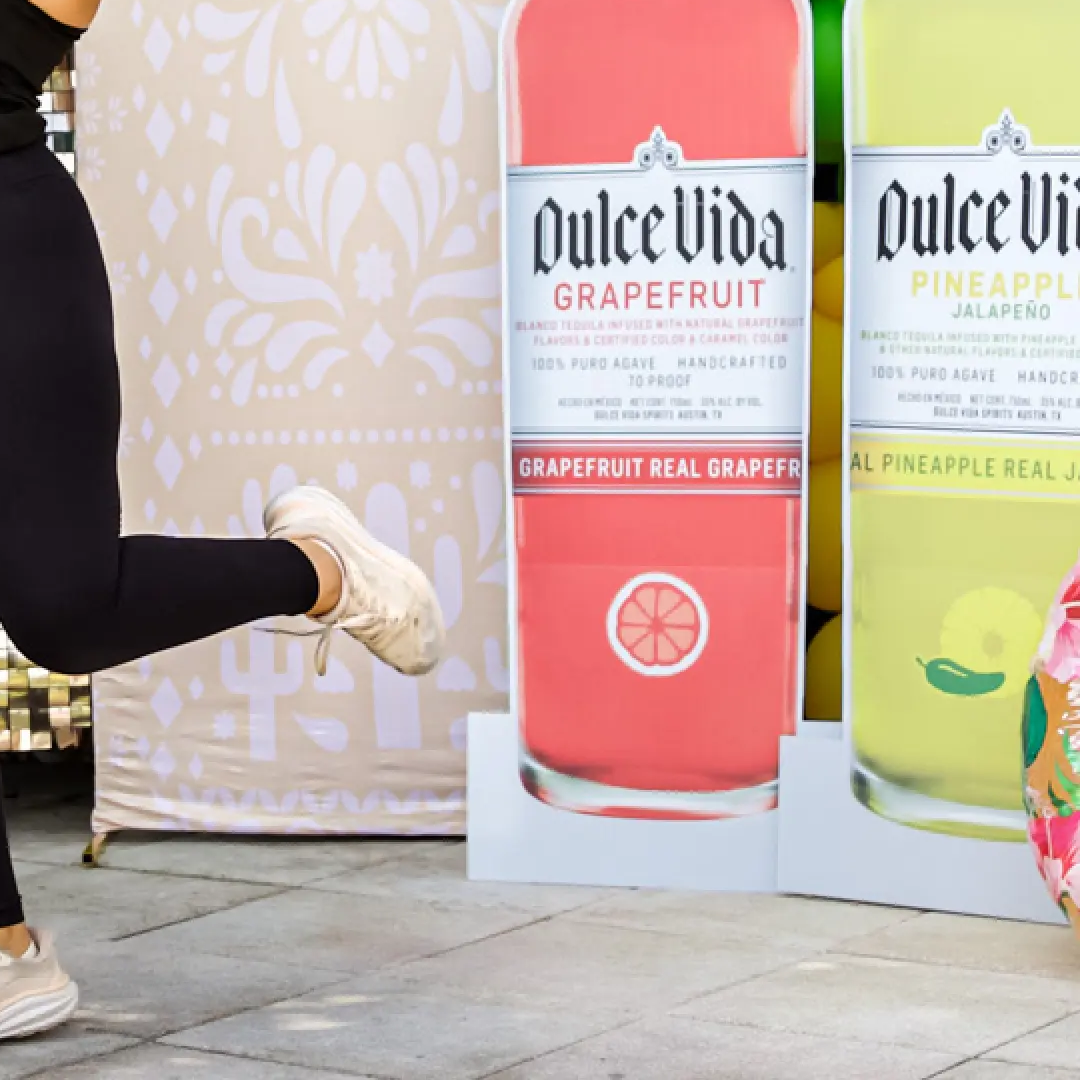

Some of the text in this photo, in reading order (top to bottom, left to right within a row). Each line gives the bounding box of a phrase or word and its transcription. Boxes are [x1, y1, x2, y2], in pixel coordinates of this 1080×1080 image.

[877, 171, 1080, 262] Dulce Vi
[533, 185, 786, 276] Dulce Vida
[554, 279, 766, 311] GRAPEFRUIT
[911, 270, 1080, 300] PINEAPPL
[952, 300, 1051, 321] JALAPEÑO
[571, 357, 607, 370] PURO
[613, 356, 655, 370] AGAVE
[677, 355, 787, 369] HANDCRAFTED
[911, 367, 947, 381] PURO
[952, 368, 995, 382] AGAVE
[648, 374, 692, 388] PROOF
[519, 457, 643, 478] GRAPEFRUIT
[650, 457, 700, 478] REAL
[882, 453, 995, 478] PINEAPPLE
[1004, 457, 1056, 481] REAL
[1063, 461, 1080, 482] J
